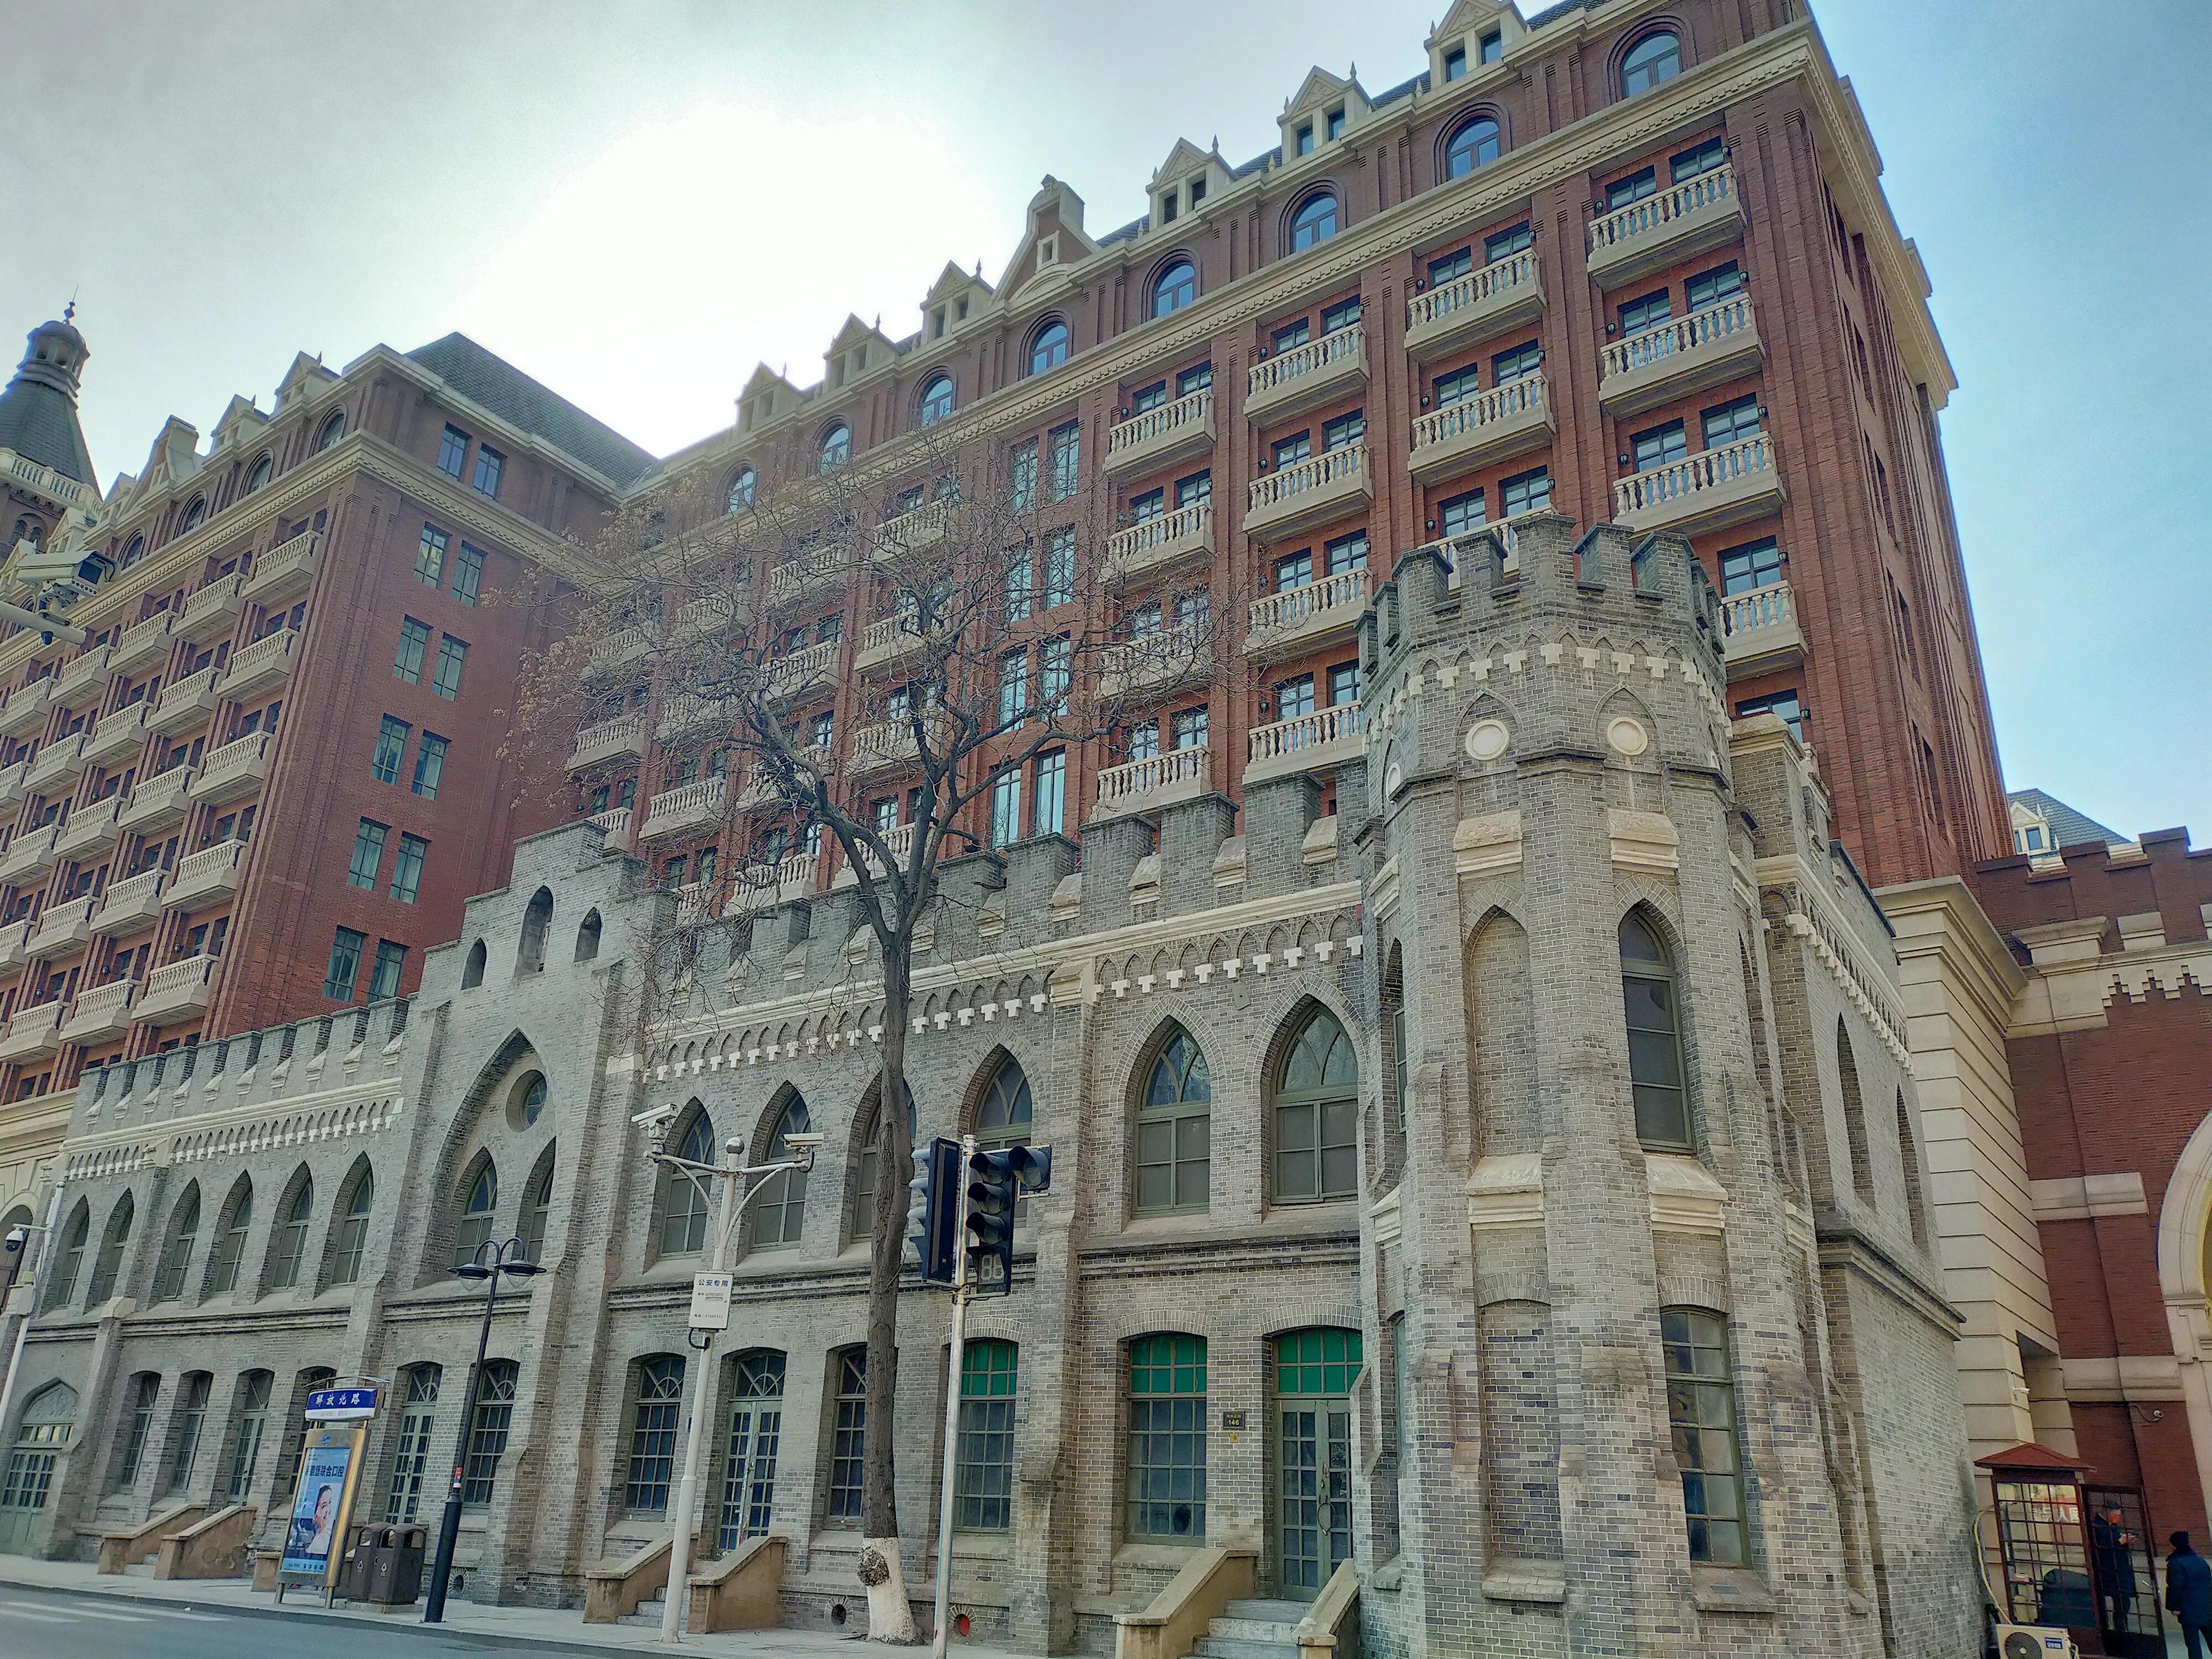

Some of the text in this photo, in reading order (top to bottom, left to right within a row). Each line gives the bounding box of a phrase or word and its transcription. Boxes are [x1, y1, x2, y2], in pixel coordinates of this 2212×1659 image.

[698, 1279, 728, 1287] 公安专用
[315, 1392, 360, 1407] 解放北路
